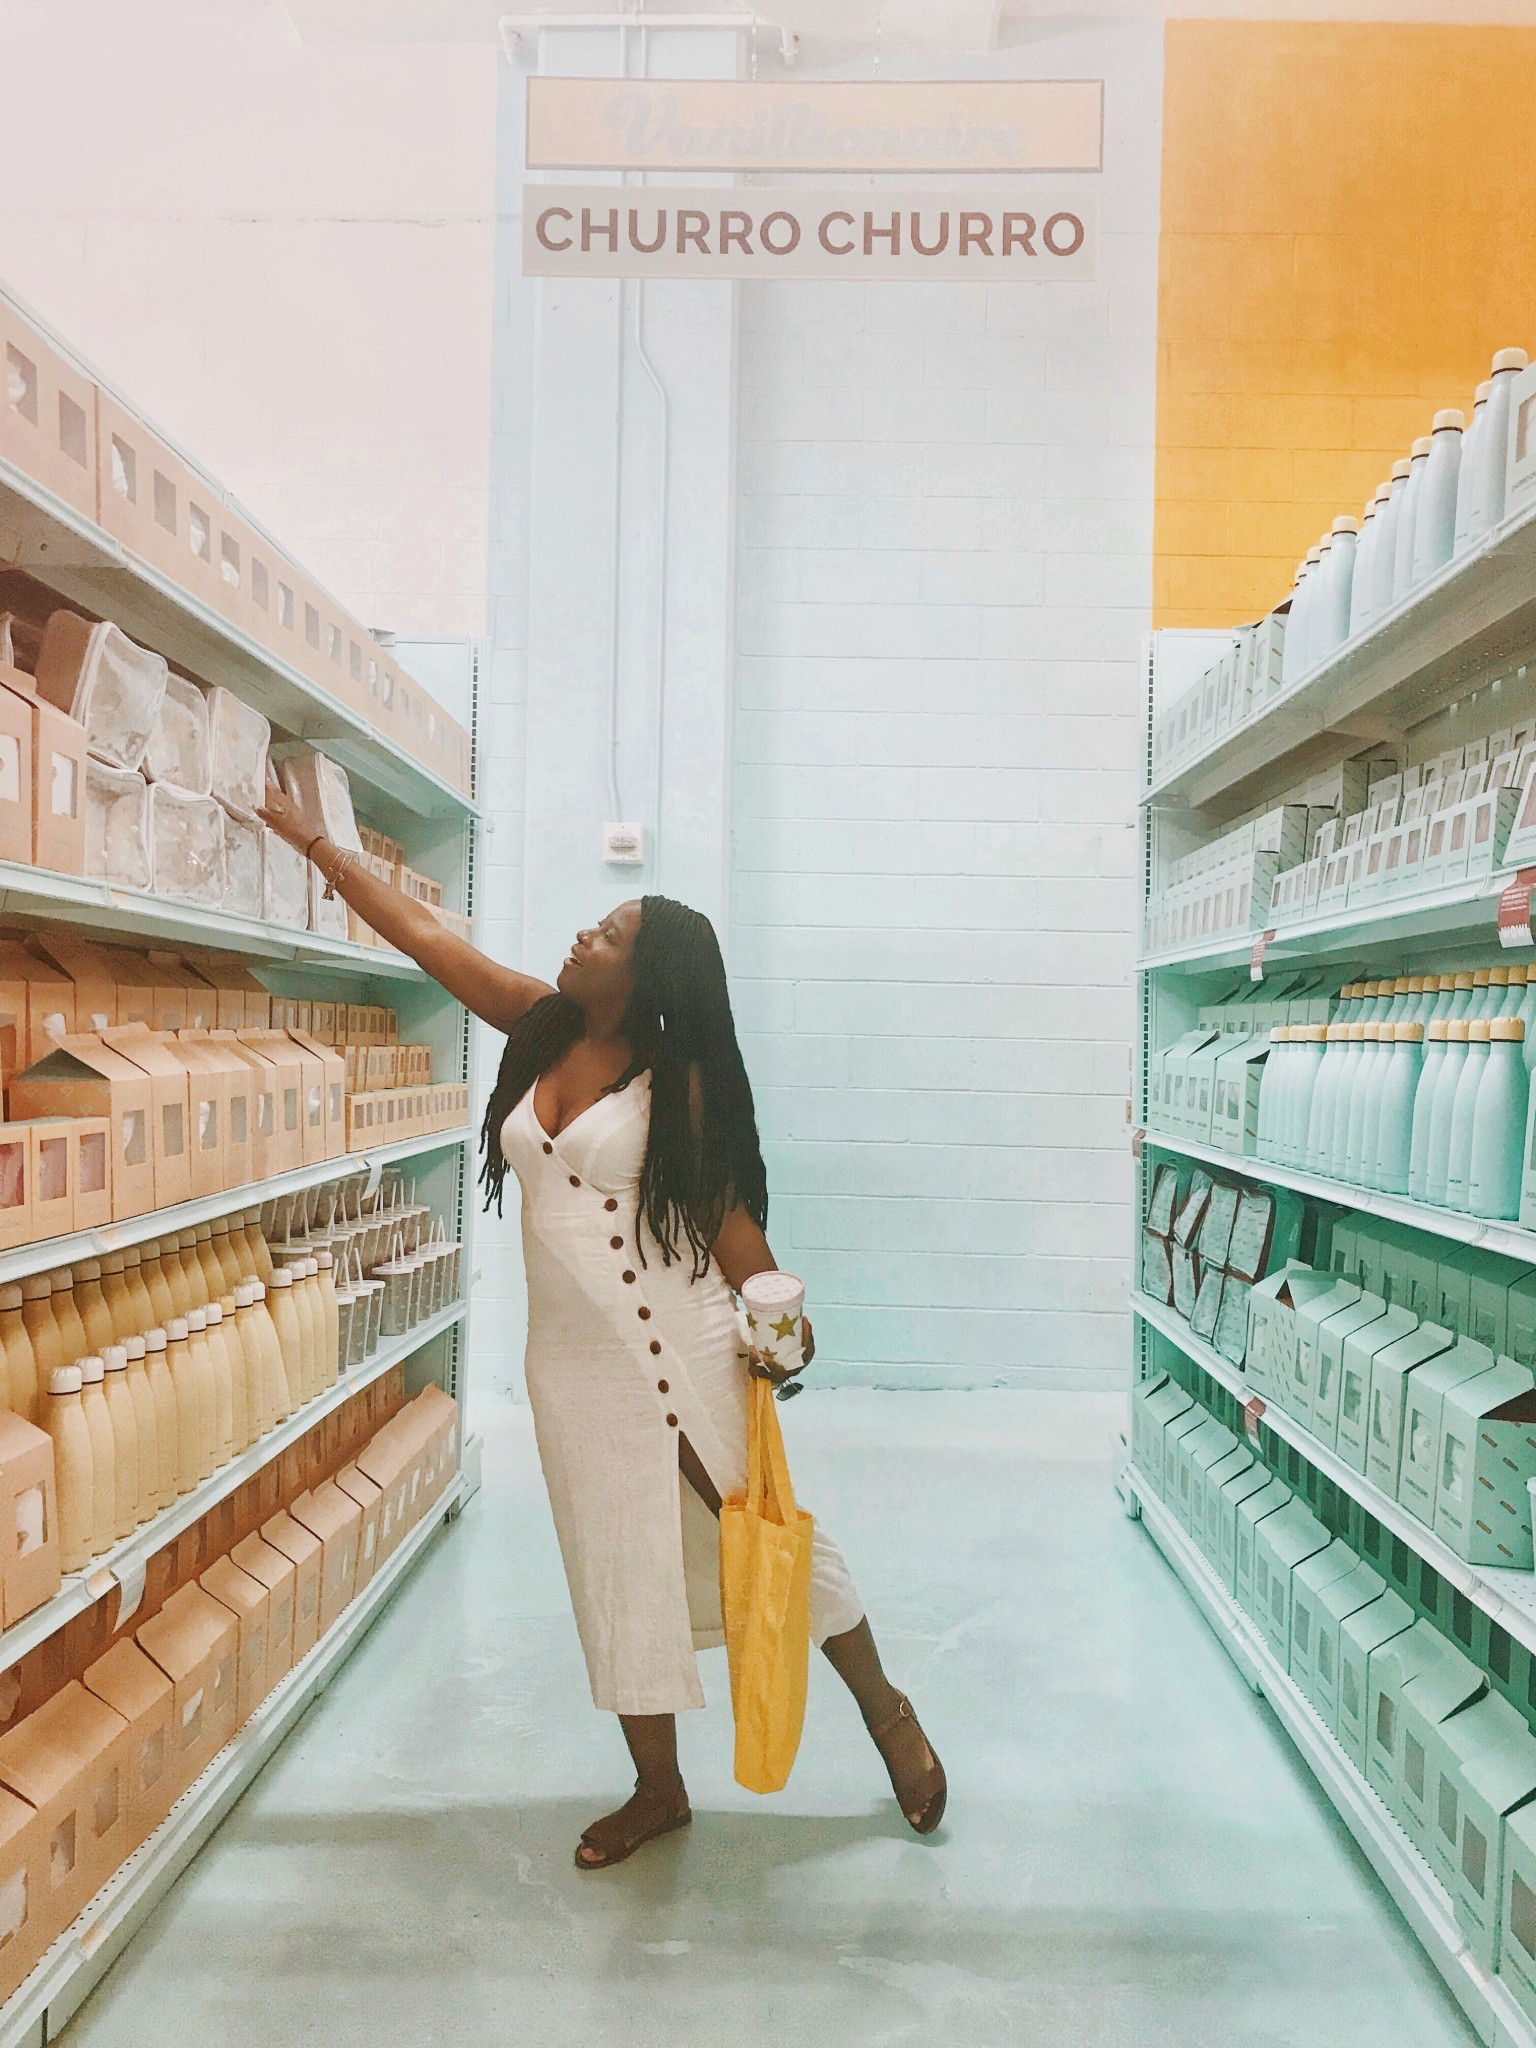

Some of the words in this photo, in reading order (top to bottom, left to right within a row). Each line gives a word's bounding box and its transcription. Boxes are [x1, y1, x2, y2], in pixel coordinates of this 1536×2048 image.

[603, 90, 1028, 158] Vanillionaire
[536, 207, 800, 254] CHURRO
[818, 211, 1084, 256] CHURRO
